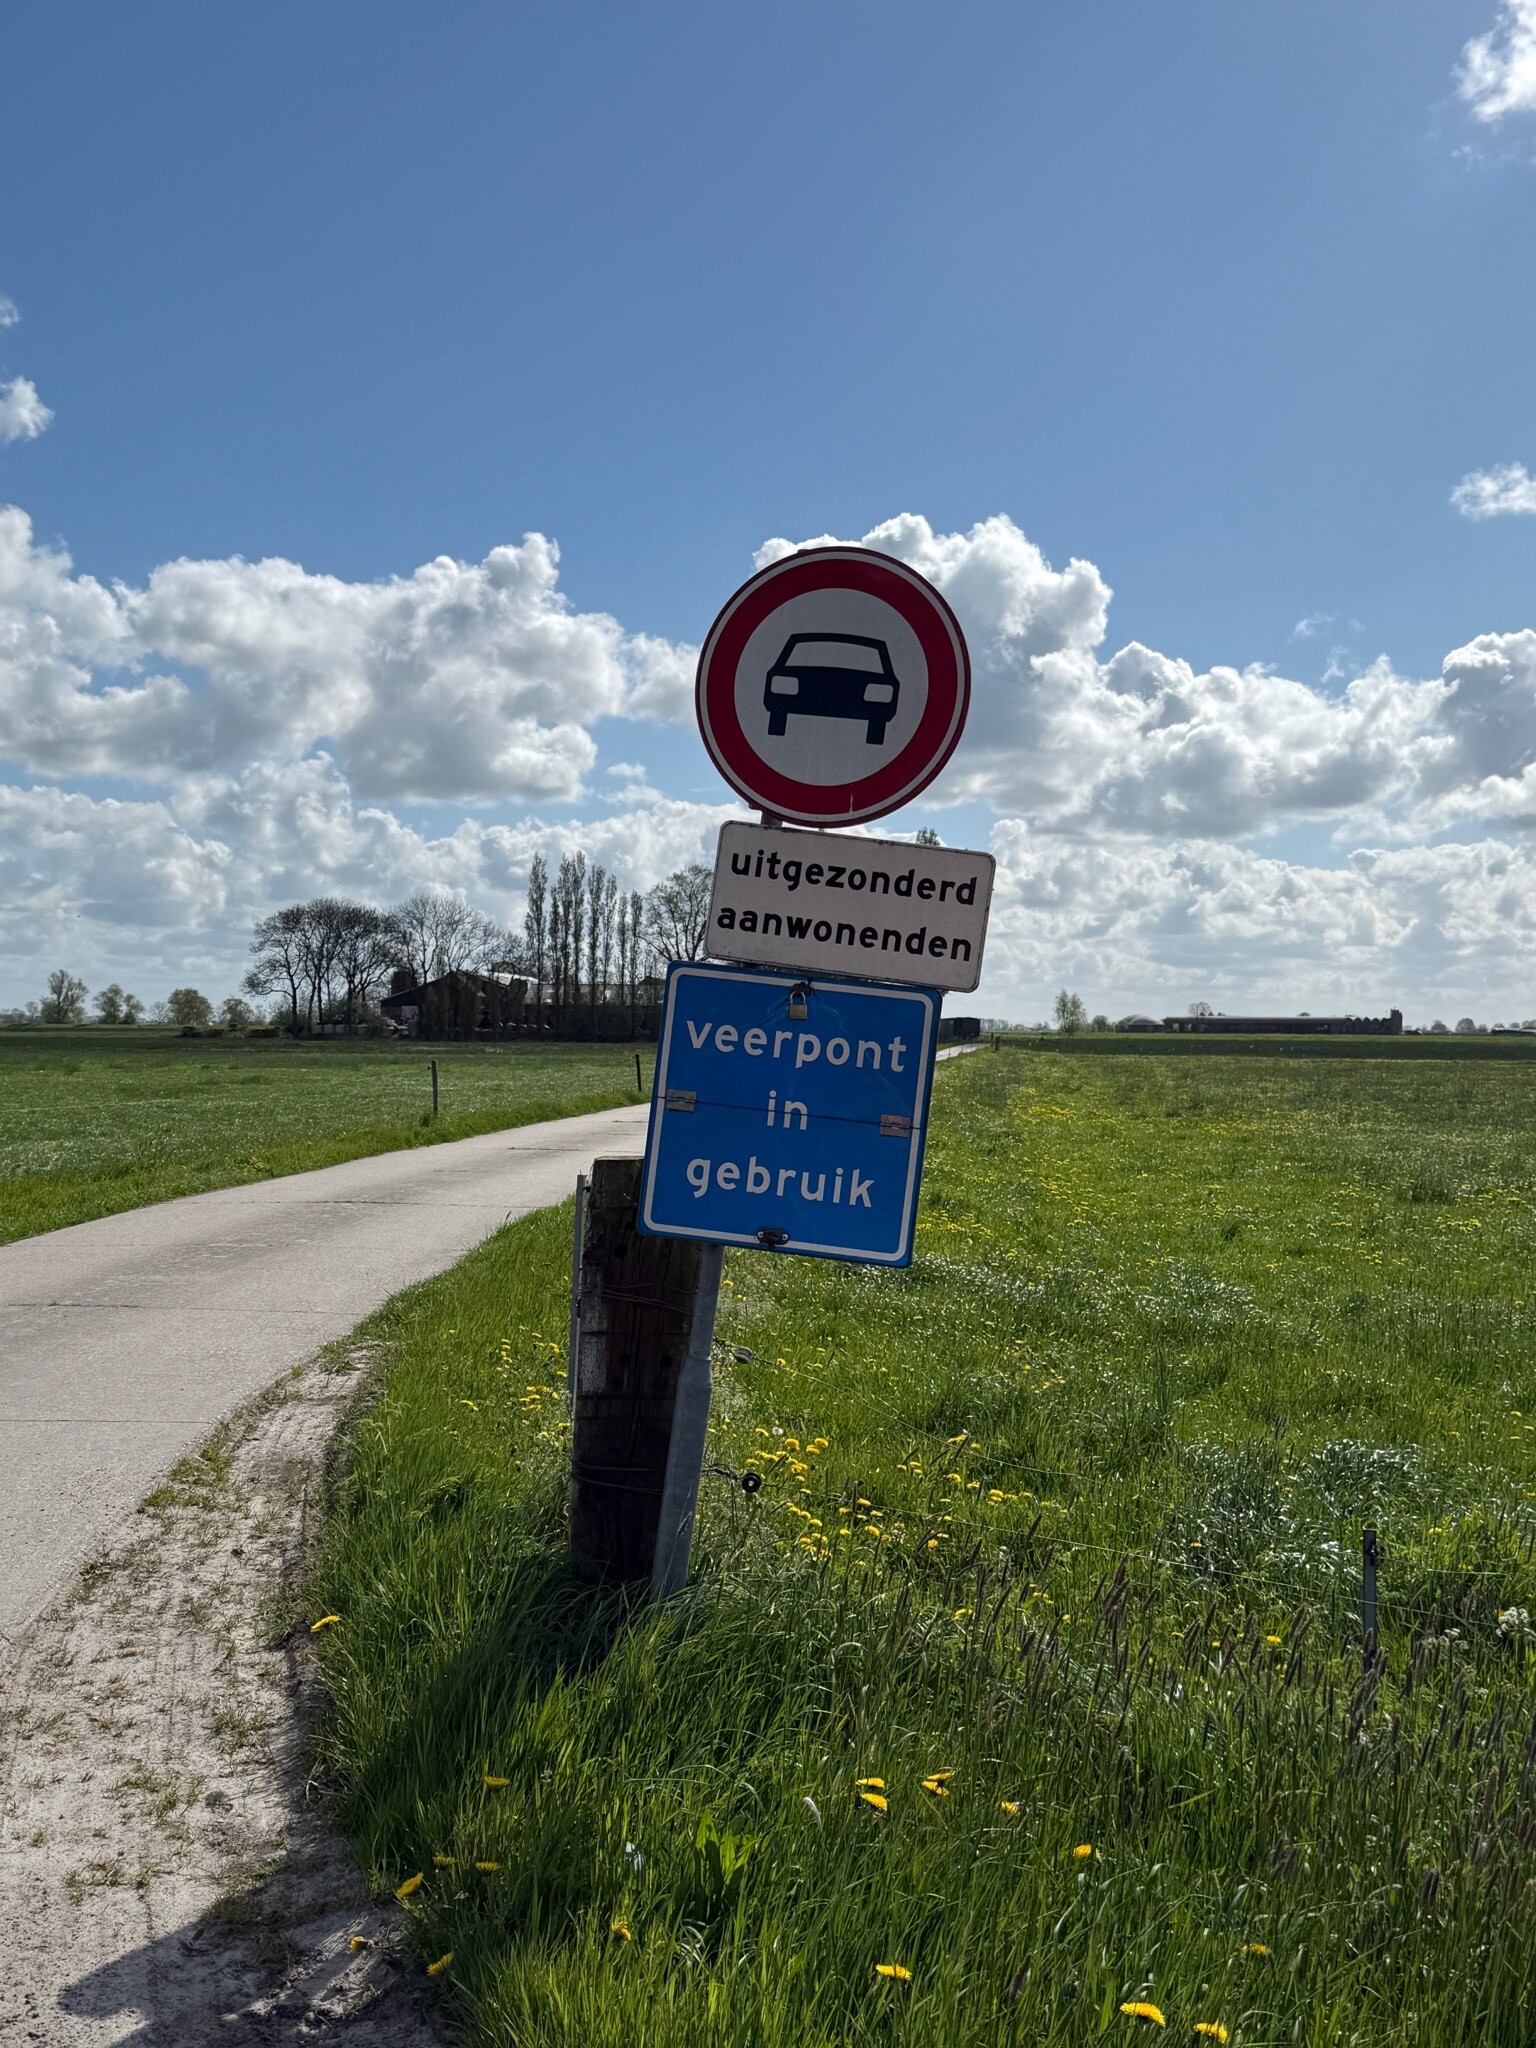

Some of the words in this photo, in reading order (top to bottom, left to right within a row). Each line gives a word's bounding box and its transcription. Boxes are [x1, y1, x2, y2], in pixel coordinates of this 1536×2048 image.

[731, 850, 977, 905] uitgezonderd
[717, 907, 972, 962] aanwonenden
[686, 1020, 907, 1072] veerpont
[766, 1090, 808, 1130] in
[686, 1156, 875, 1208] gebruik
